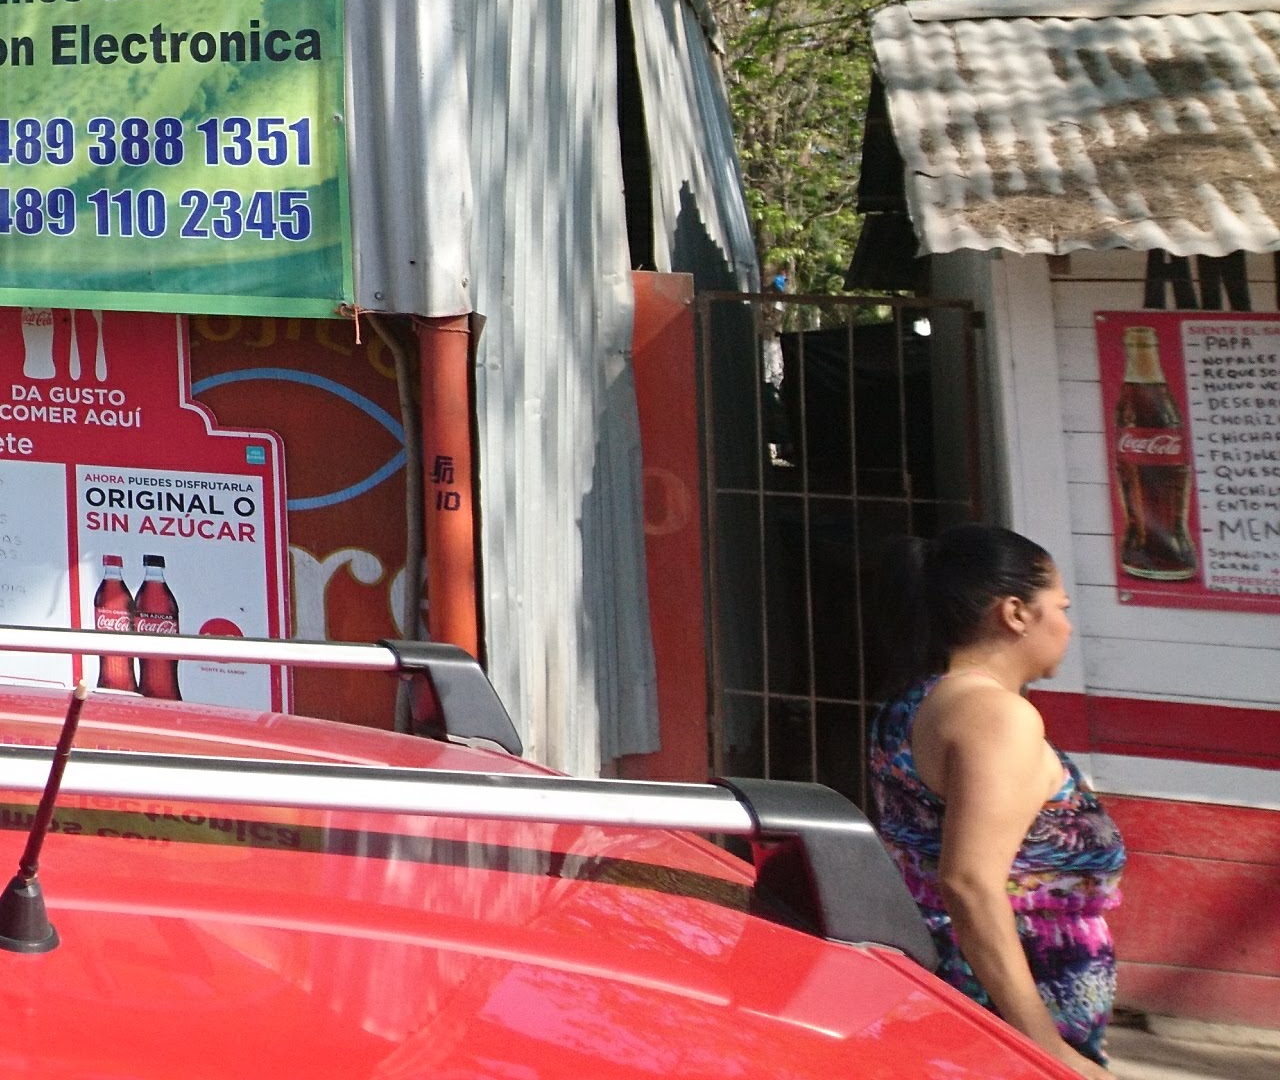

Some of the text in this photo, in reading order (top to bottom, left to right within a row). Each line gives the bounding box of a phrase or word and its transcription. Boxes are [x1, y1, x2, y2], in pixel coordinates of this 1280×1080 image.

[51, 19, 322, 67] Electronica
[87, 117, 184, 167] 388
[196, 116, 312, 168] 1351
[87, 187, 167, 238] 110
[179, 189, 312, 242] 2345
[1205, 335, 1252, 351] PAPA
[1203, 368, 1280, 379] REQUESO
[11, 384, 126, 407] DA GUSTO
[1208, 397, 1280, 411] DESEBR
[84, 407, 141, 428] AQUÍ
[1210, 412, 1280, 426] CHORIZ
[84, 473, 254, 494] AHORA PUEDES DISFRUTARLA
[1215, 484, 1280, 496] ENCHIL
[85, 487, 256, 518] ORIGINAL O
[85, 511, 257, 544] SIN AZÚCAR
[97, 615, 130, 632] Coca-Col
